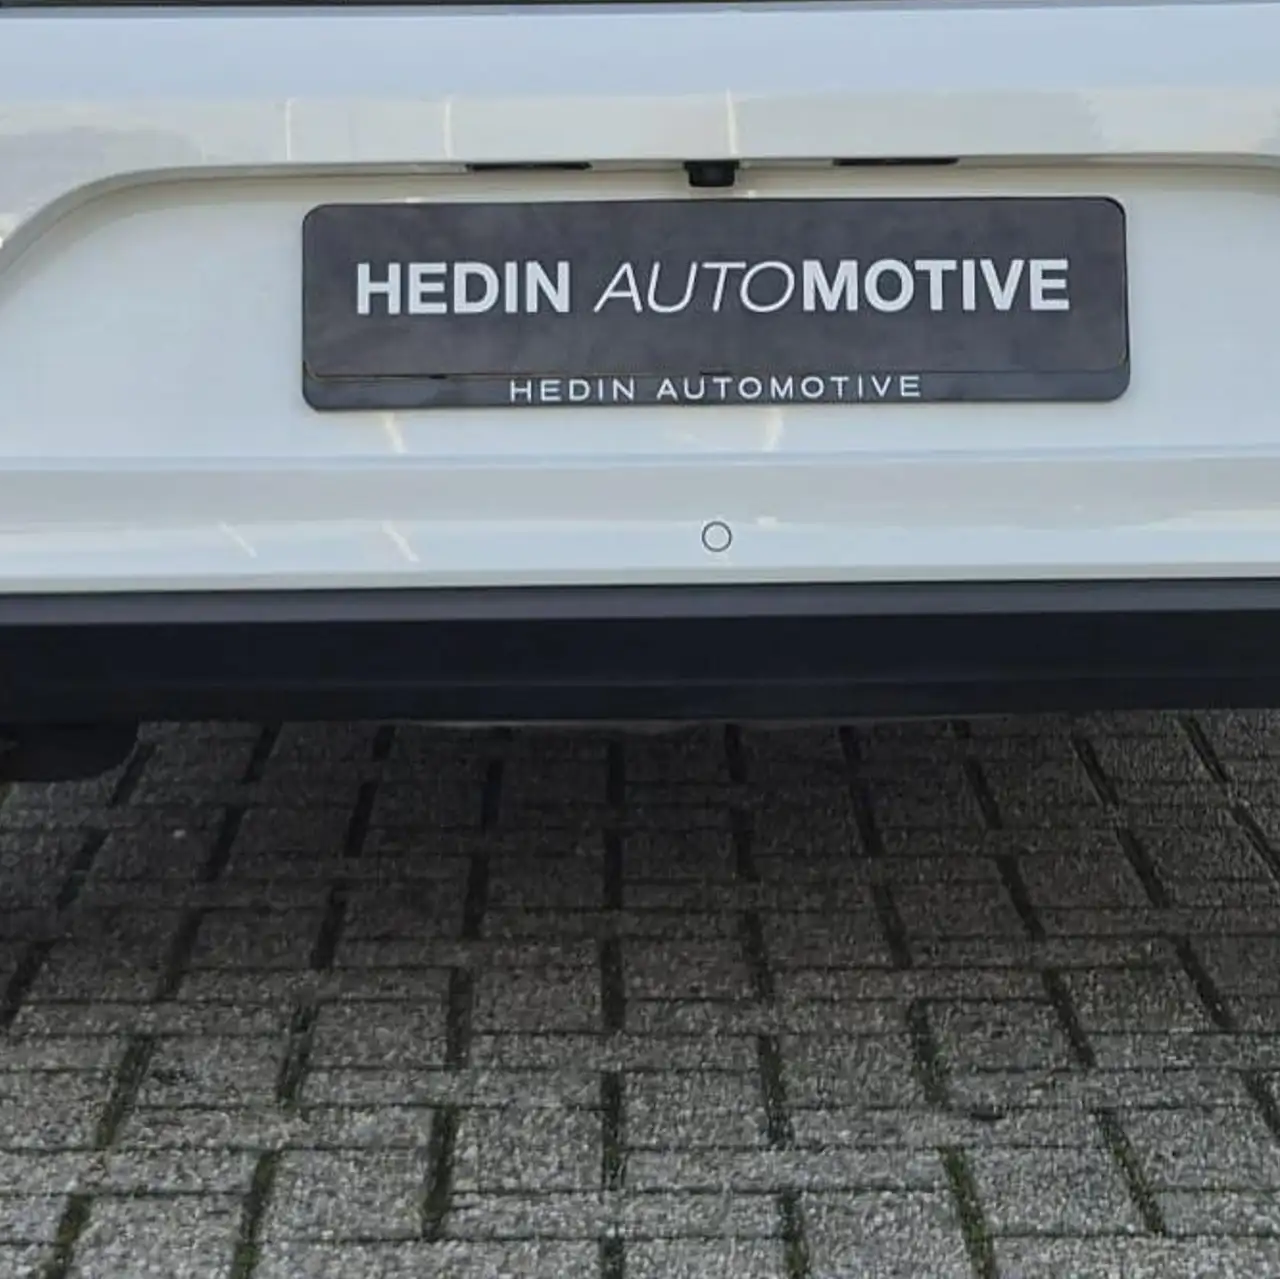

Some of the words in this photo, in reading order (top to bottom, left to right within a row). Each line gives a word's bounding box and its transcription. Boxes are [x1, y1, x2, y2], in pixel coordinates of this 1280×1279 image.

[356, 260, 571, 314] HEDIN
[593, 258, 1070, 314] AUTOMOTIVE
[509, 376, 635, 403] HEDIN
[656, 374, 922, 402] AUTOMOTIVE
